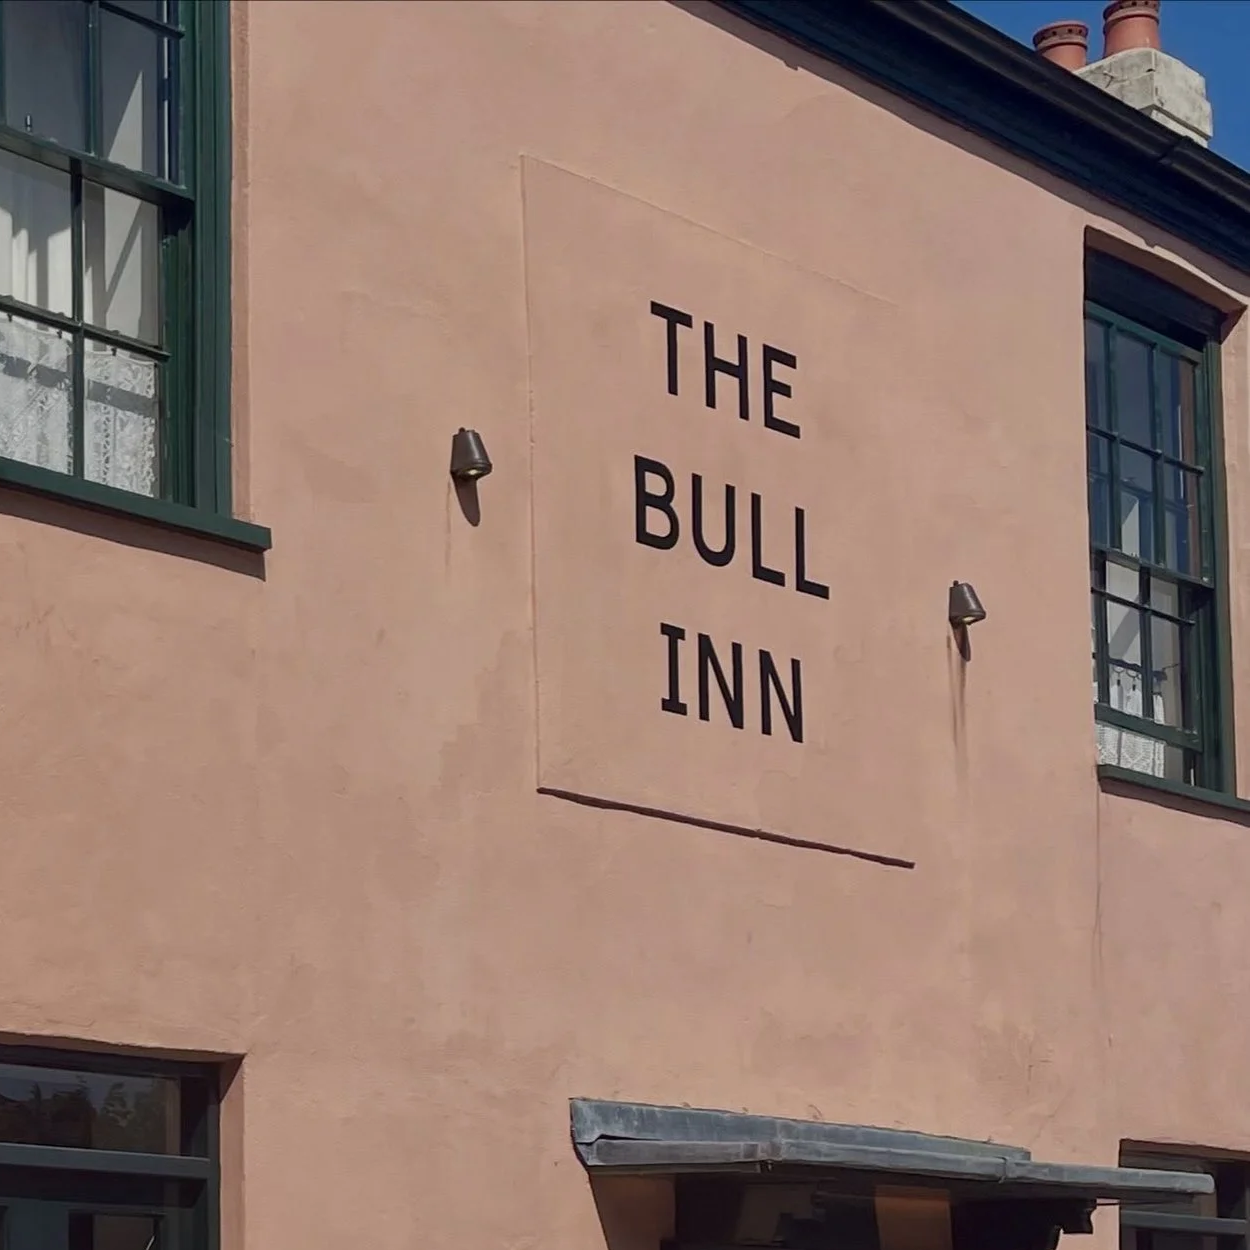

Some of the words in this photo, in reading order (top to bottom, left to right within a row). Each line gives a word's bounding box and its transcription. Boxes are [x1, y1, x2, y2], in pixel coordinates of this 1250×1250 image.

[650, 300, 801, 439] THE
[634, 454, 830, 600] BULL
[660, 622, 804, 744] INN
